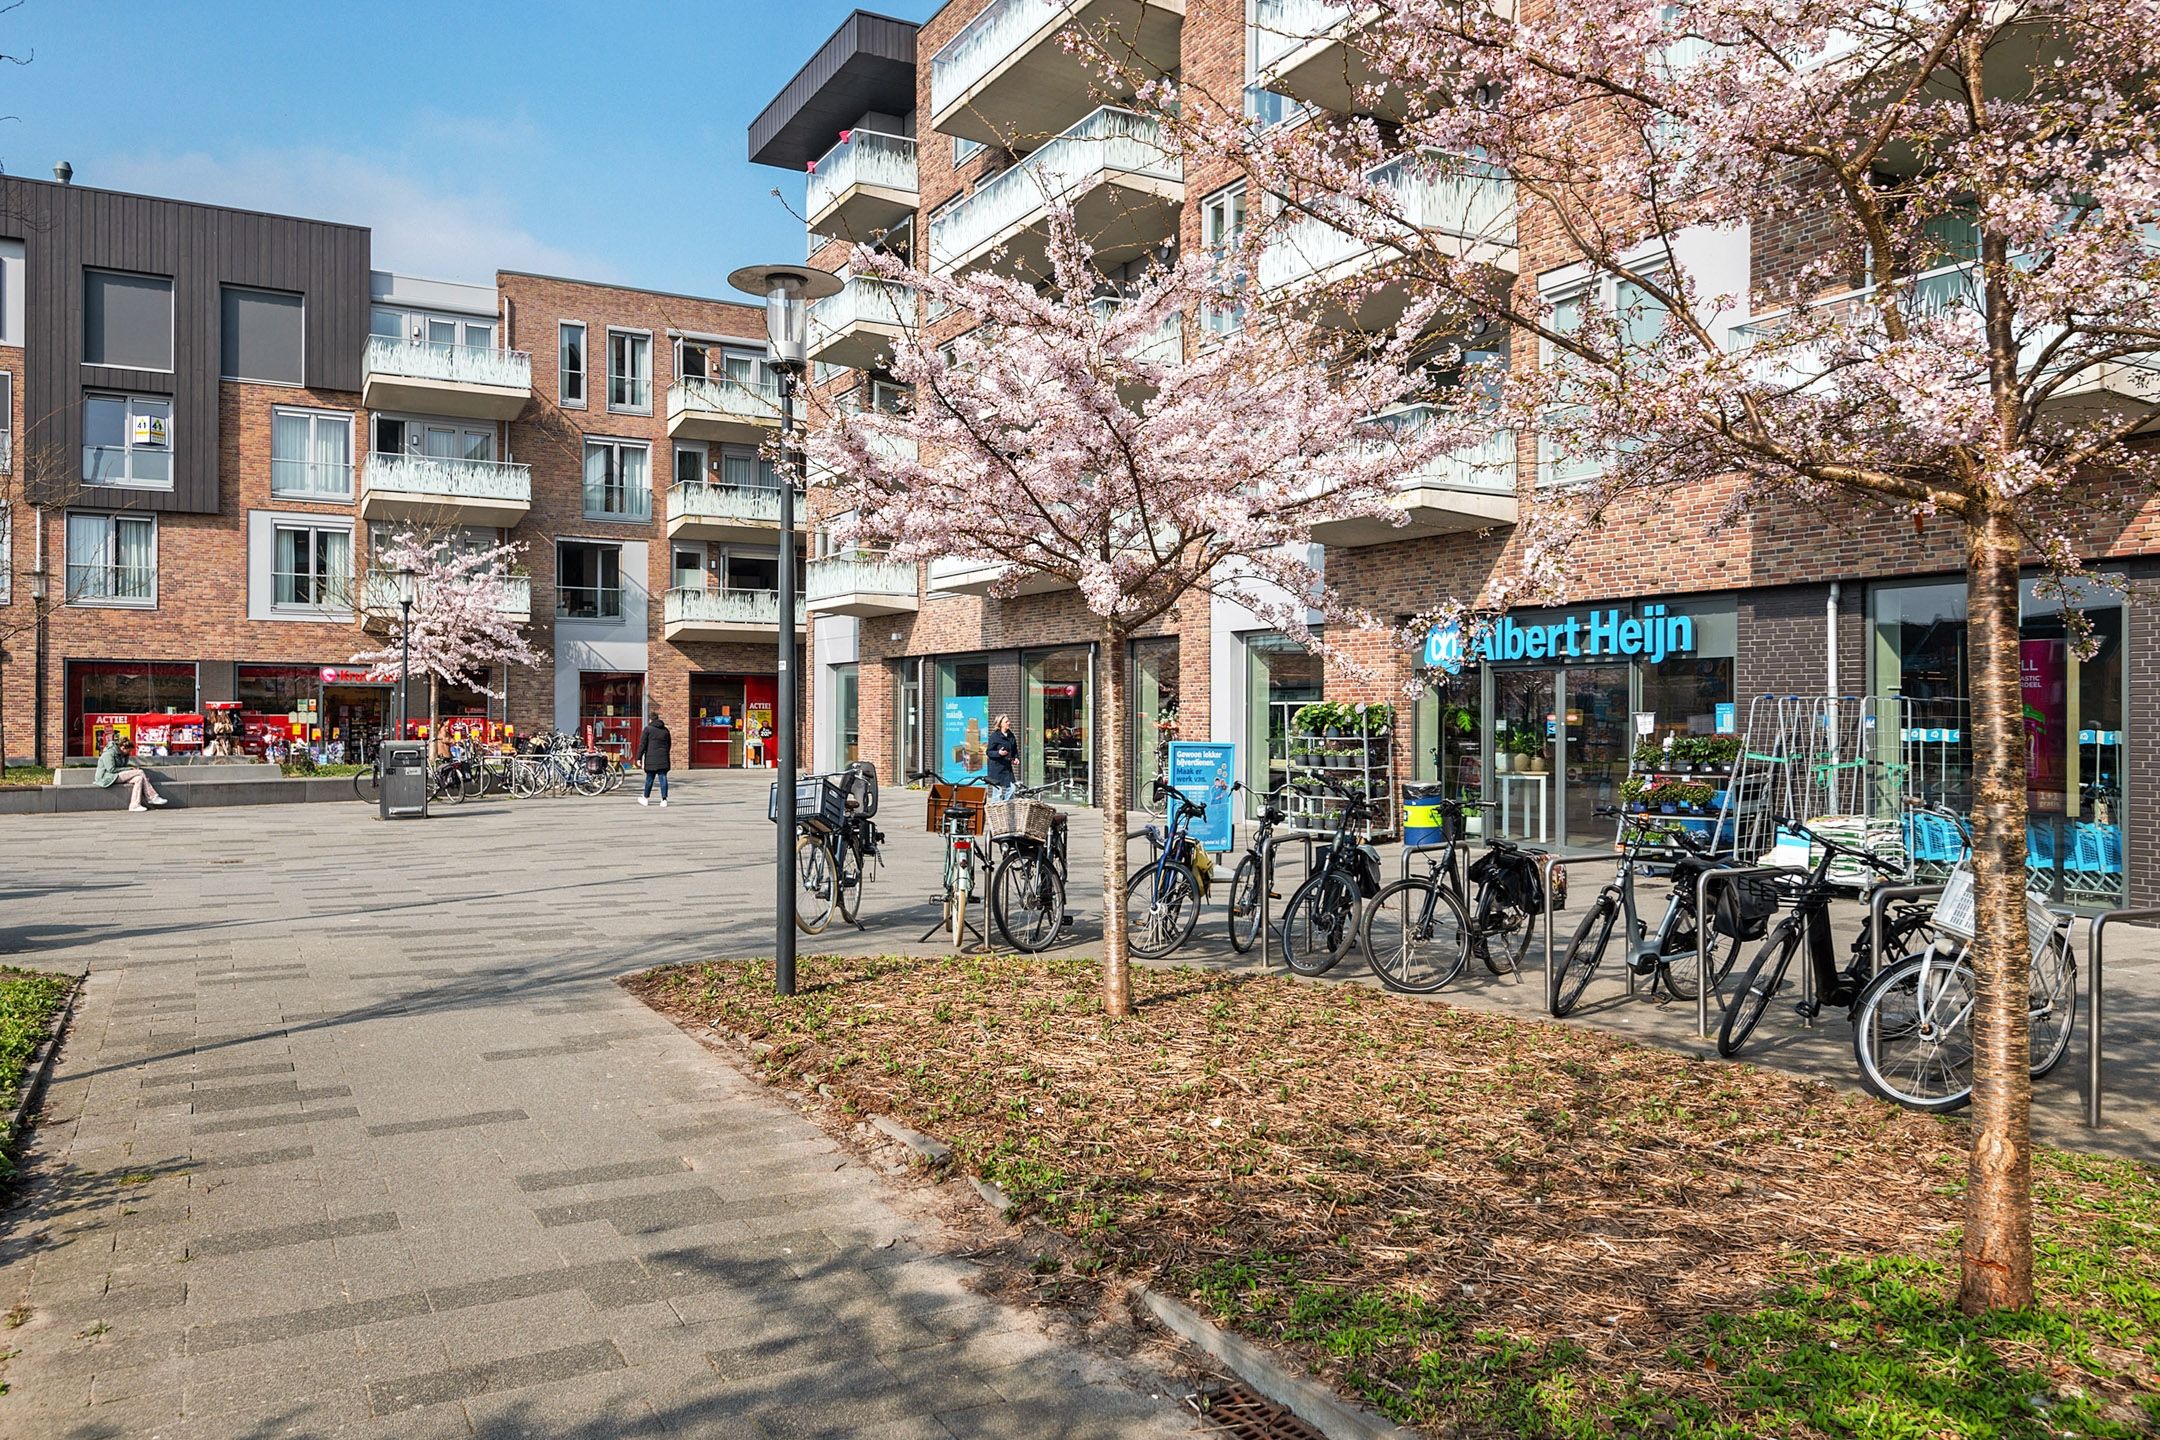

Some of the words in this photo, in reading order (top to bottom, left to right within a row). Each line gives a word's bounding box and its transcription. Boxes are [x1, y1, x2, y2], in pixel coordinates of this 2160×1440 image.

[1471, 615, 1581, 662] Albert
[1590, 604, 1693, 664] Heijn
[749, 702, 771, 710] ACTIE!
[95, 715, 128, 724] ACTIE!
[1176, 758, 1215, 767] bijverdienen.
